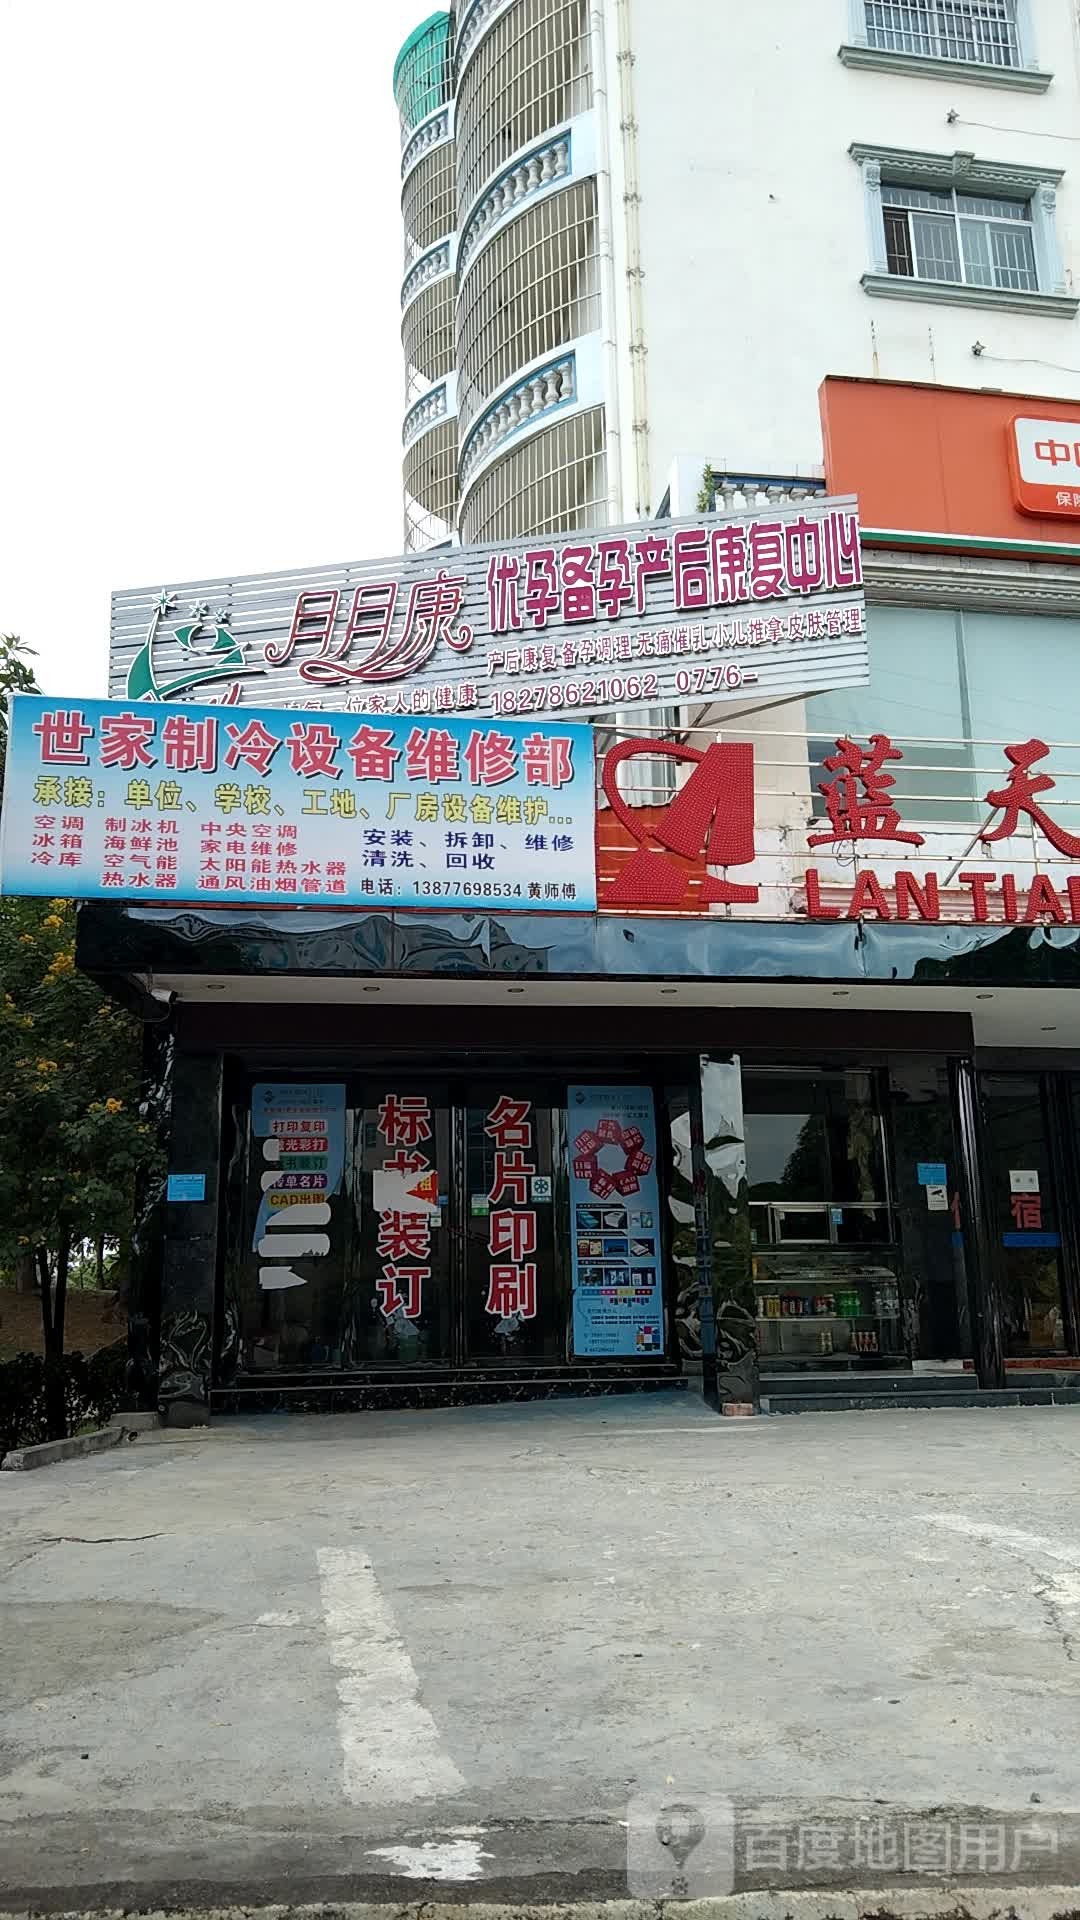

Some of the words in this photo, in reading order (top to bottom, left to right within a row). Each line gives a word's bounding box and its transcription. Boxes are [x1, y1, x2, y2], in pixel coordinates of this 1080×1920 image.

[1034, 439, 1080, 467] 中
[487, 511, 862, 632] 优孕备孕产后康复中心
[490, 672, 658, 714] 18278621062
[33, 710, 576, 789] 世家制冷设备维修部
[34, 815, 84, 831] 空调
[105, 818, 179, 834] 制冰机
[200, 821, 298, 839] 中央空调
[32, 833, 82, 849] 冰箱
[104, 836, 178, 852] 海鲜池
[200, 840, 297, 857] 家电维修
[31, 851, 82, 867] 冷库
[104, 854, 177, 870] 空气能
[200, 858, 347, 877] 太阳能热水器
[102, 872, 177, 888] 热水器
[198, 875, 347, 894] 通风油烟管道
[958, 872, 1080, 925] TIA
[484, 1096, 537, 1318] 名片印刷
